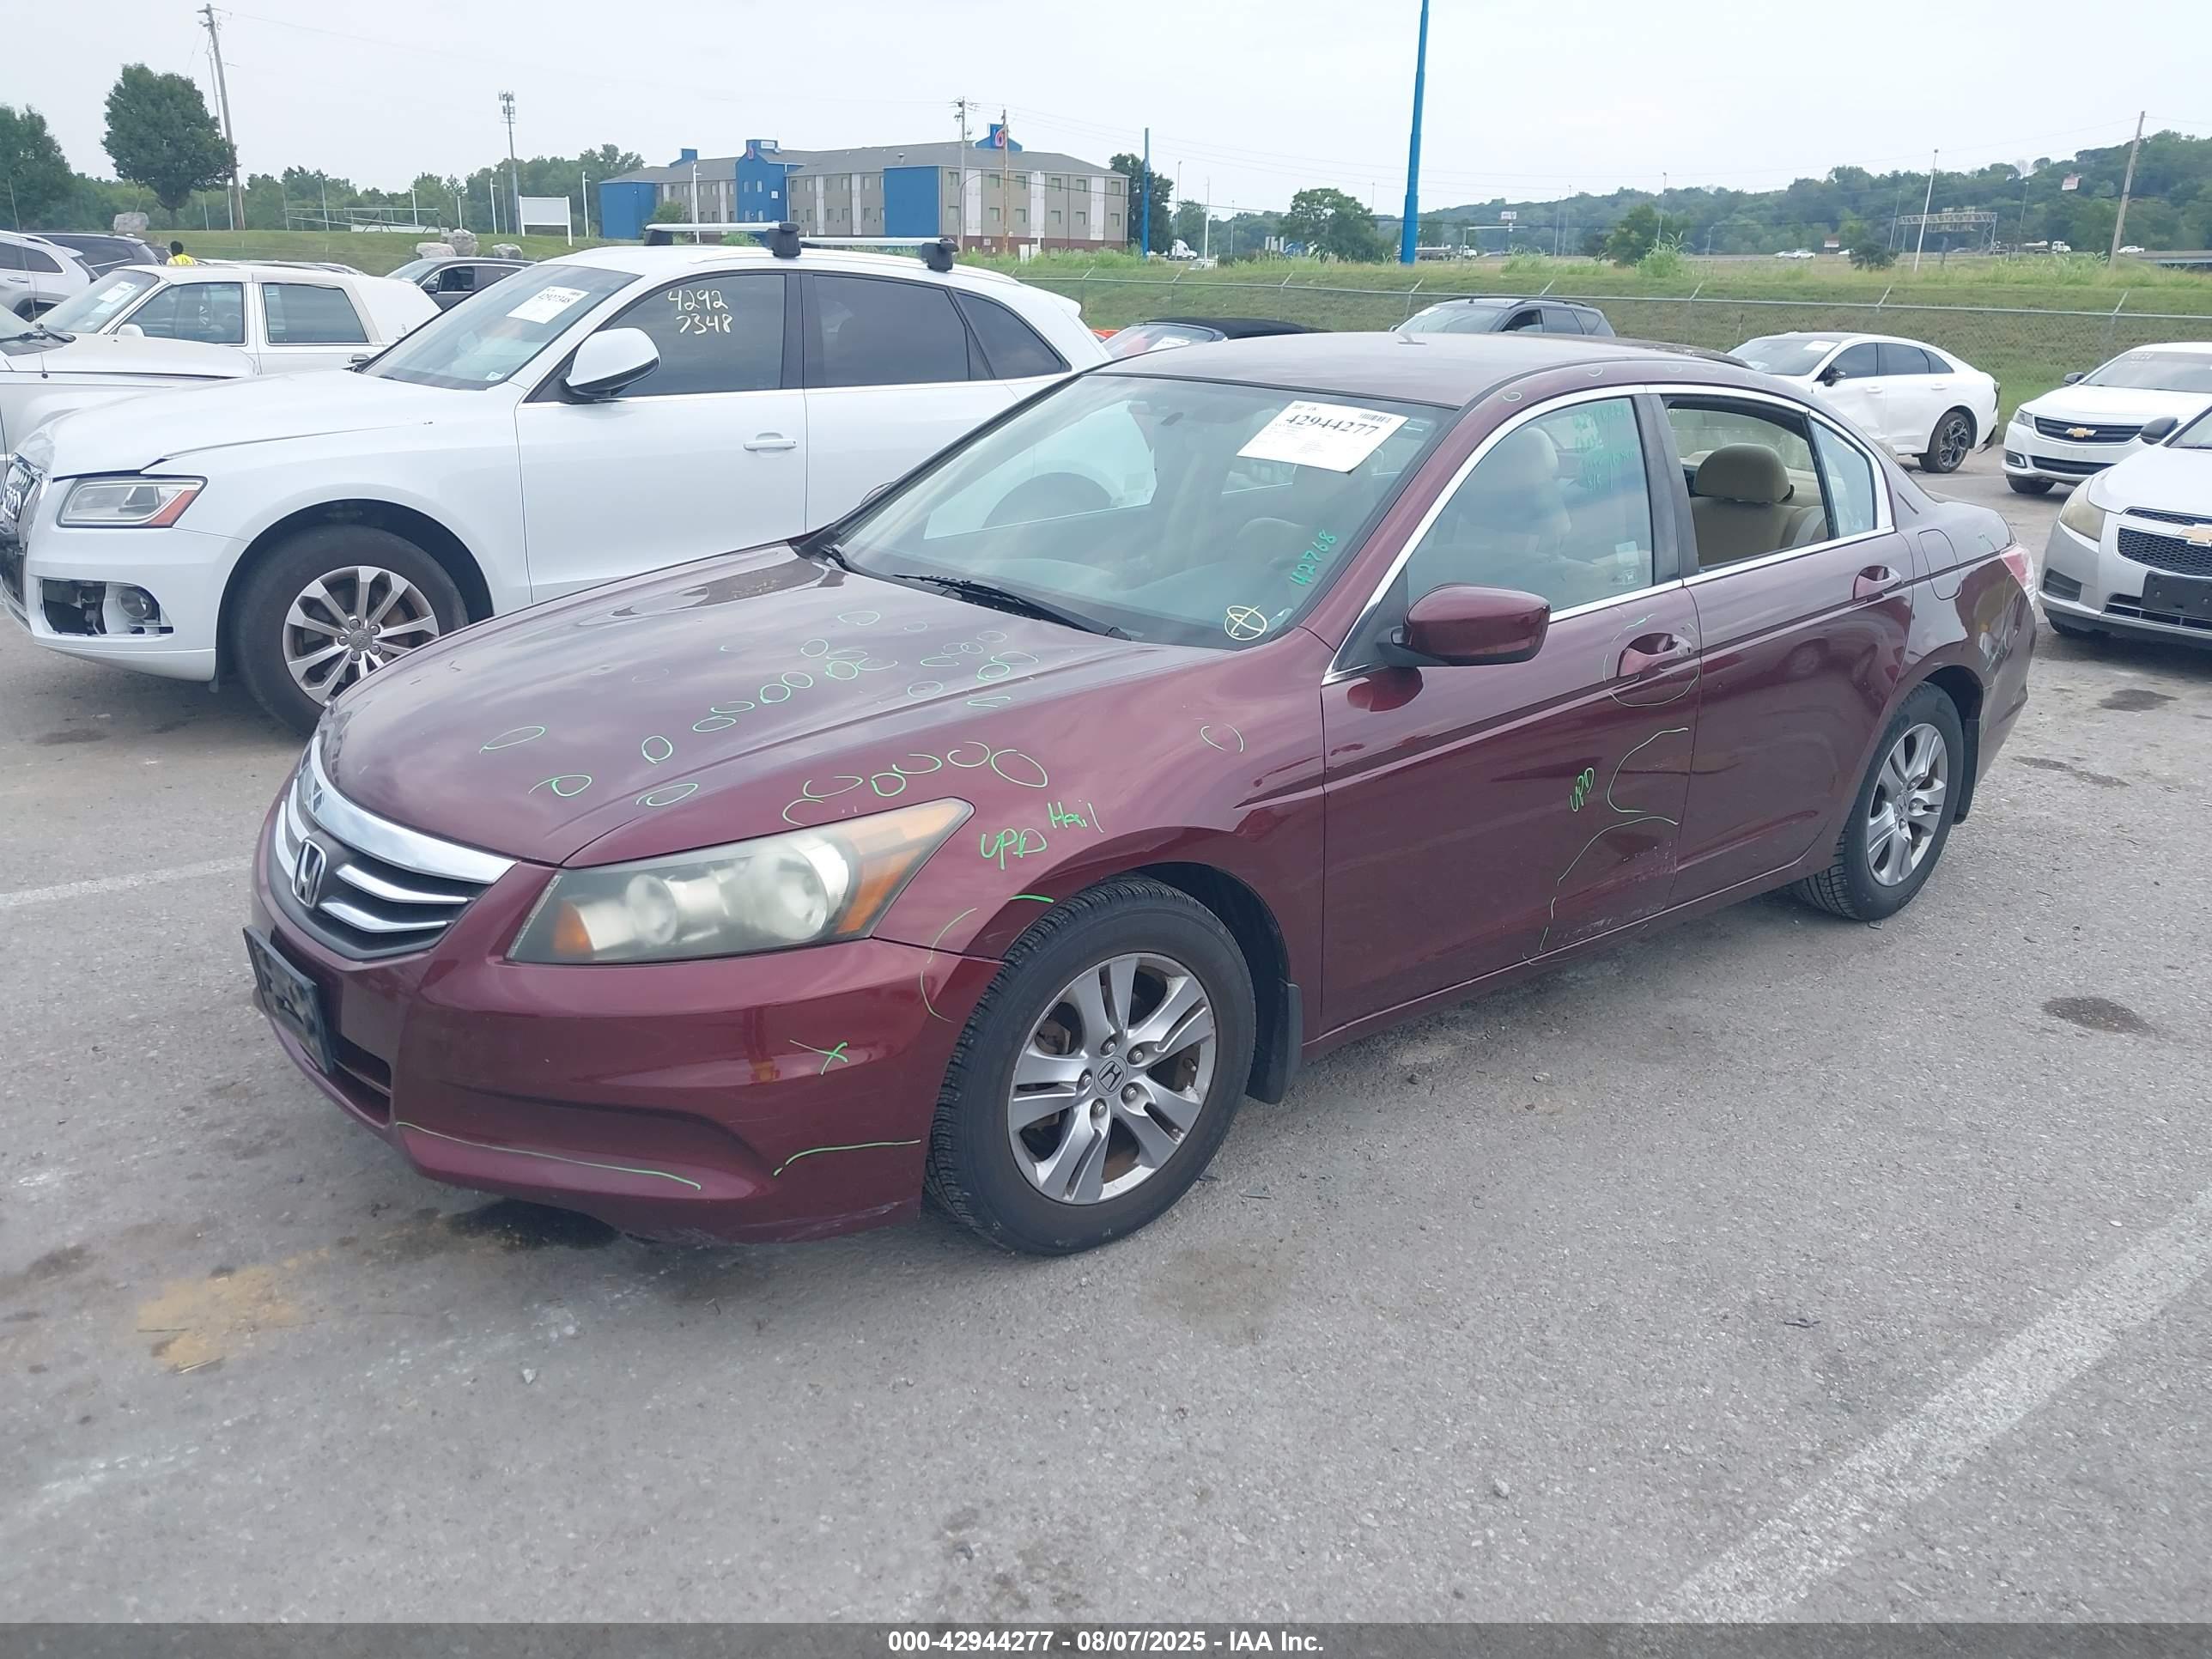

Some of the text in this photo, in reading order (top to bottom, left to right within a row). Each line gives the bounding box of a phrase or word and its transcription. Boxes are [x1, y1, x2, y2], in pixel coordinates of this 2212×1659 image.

[667, 289, 729, 311] 4292
[675, 313, 733, 334] 7348
[1285, 413, 1380, 436] 42944277
[1048, 799, 1105, 833] Hail
